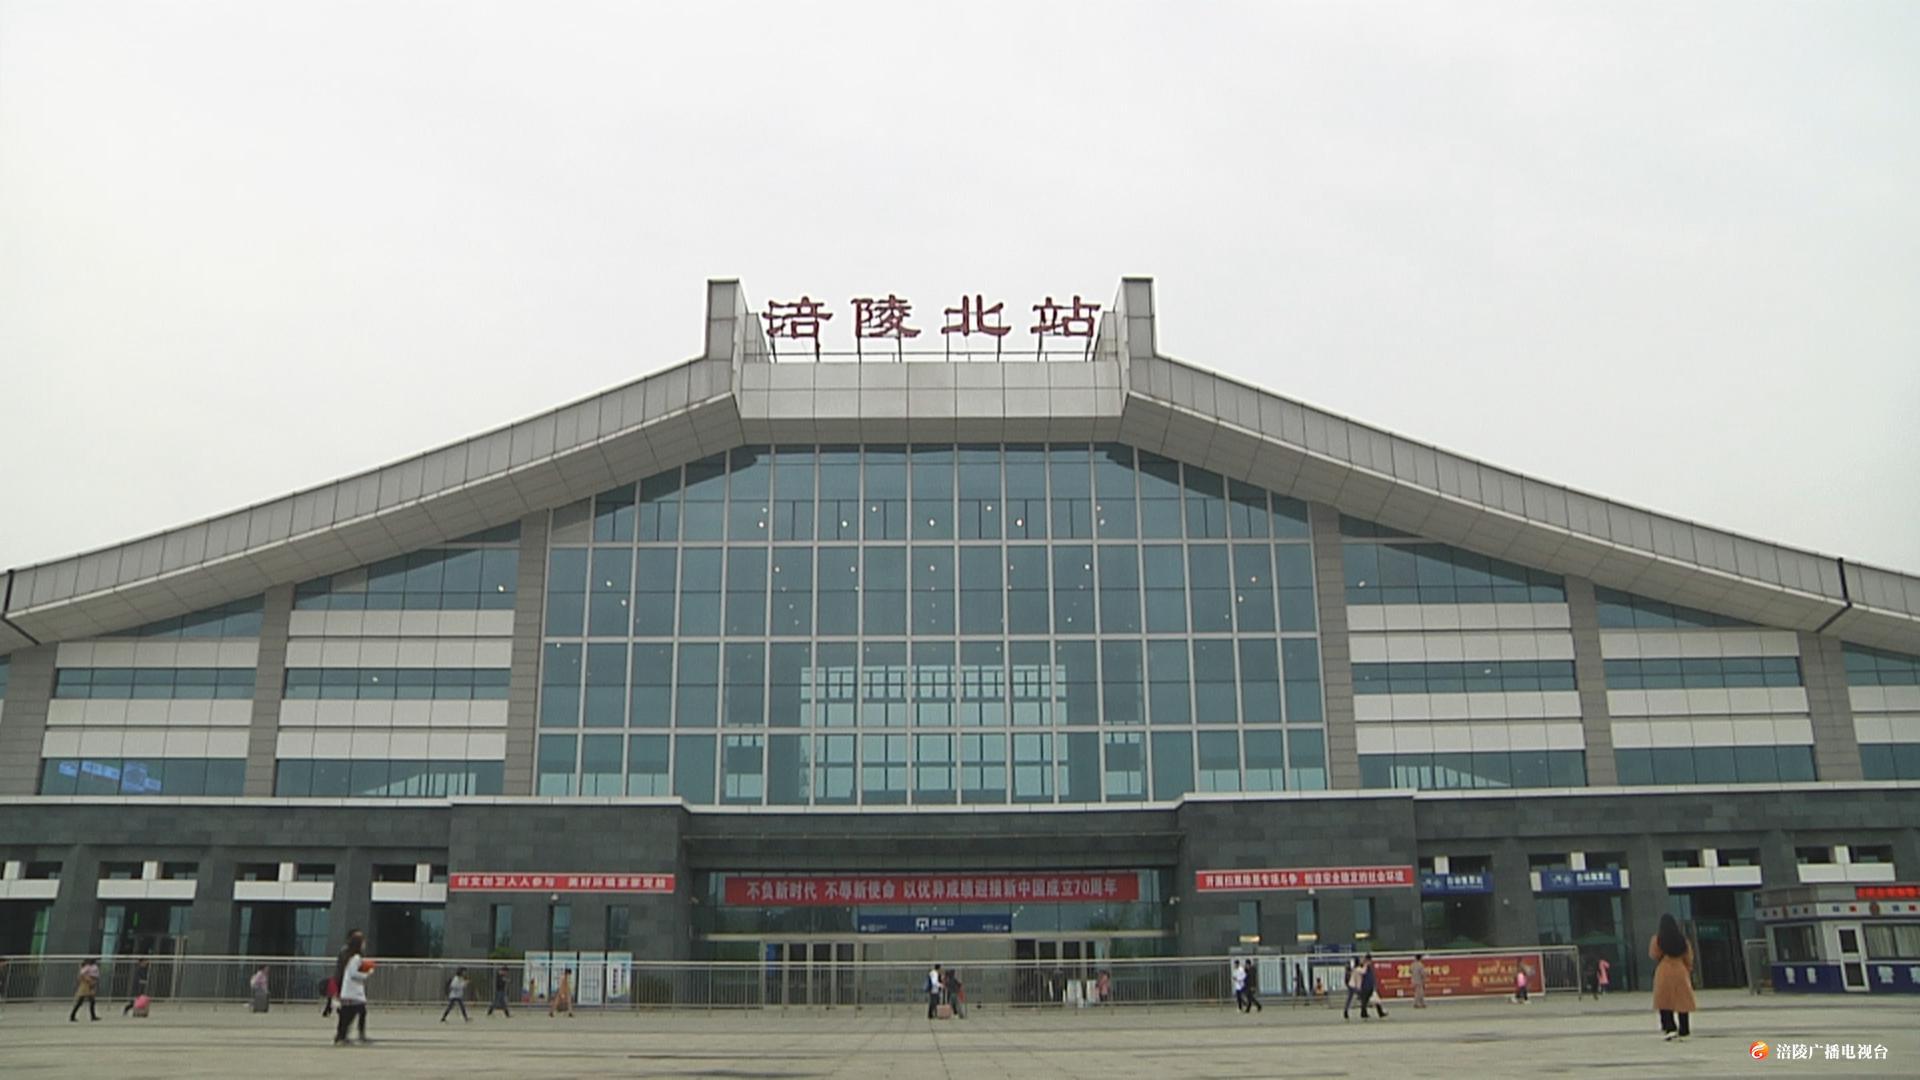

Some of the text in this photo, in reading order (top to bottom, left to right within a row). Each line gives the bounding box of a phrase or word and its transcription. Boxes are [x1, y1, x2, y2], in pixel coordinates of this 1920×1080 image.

[763, 294, 1101, 338] 涪陵北站
[747, 877, 1117, 900] 不负新时代 不辱新使命 以优异成绩迎接新中国成立70周年
